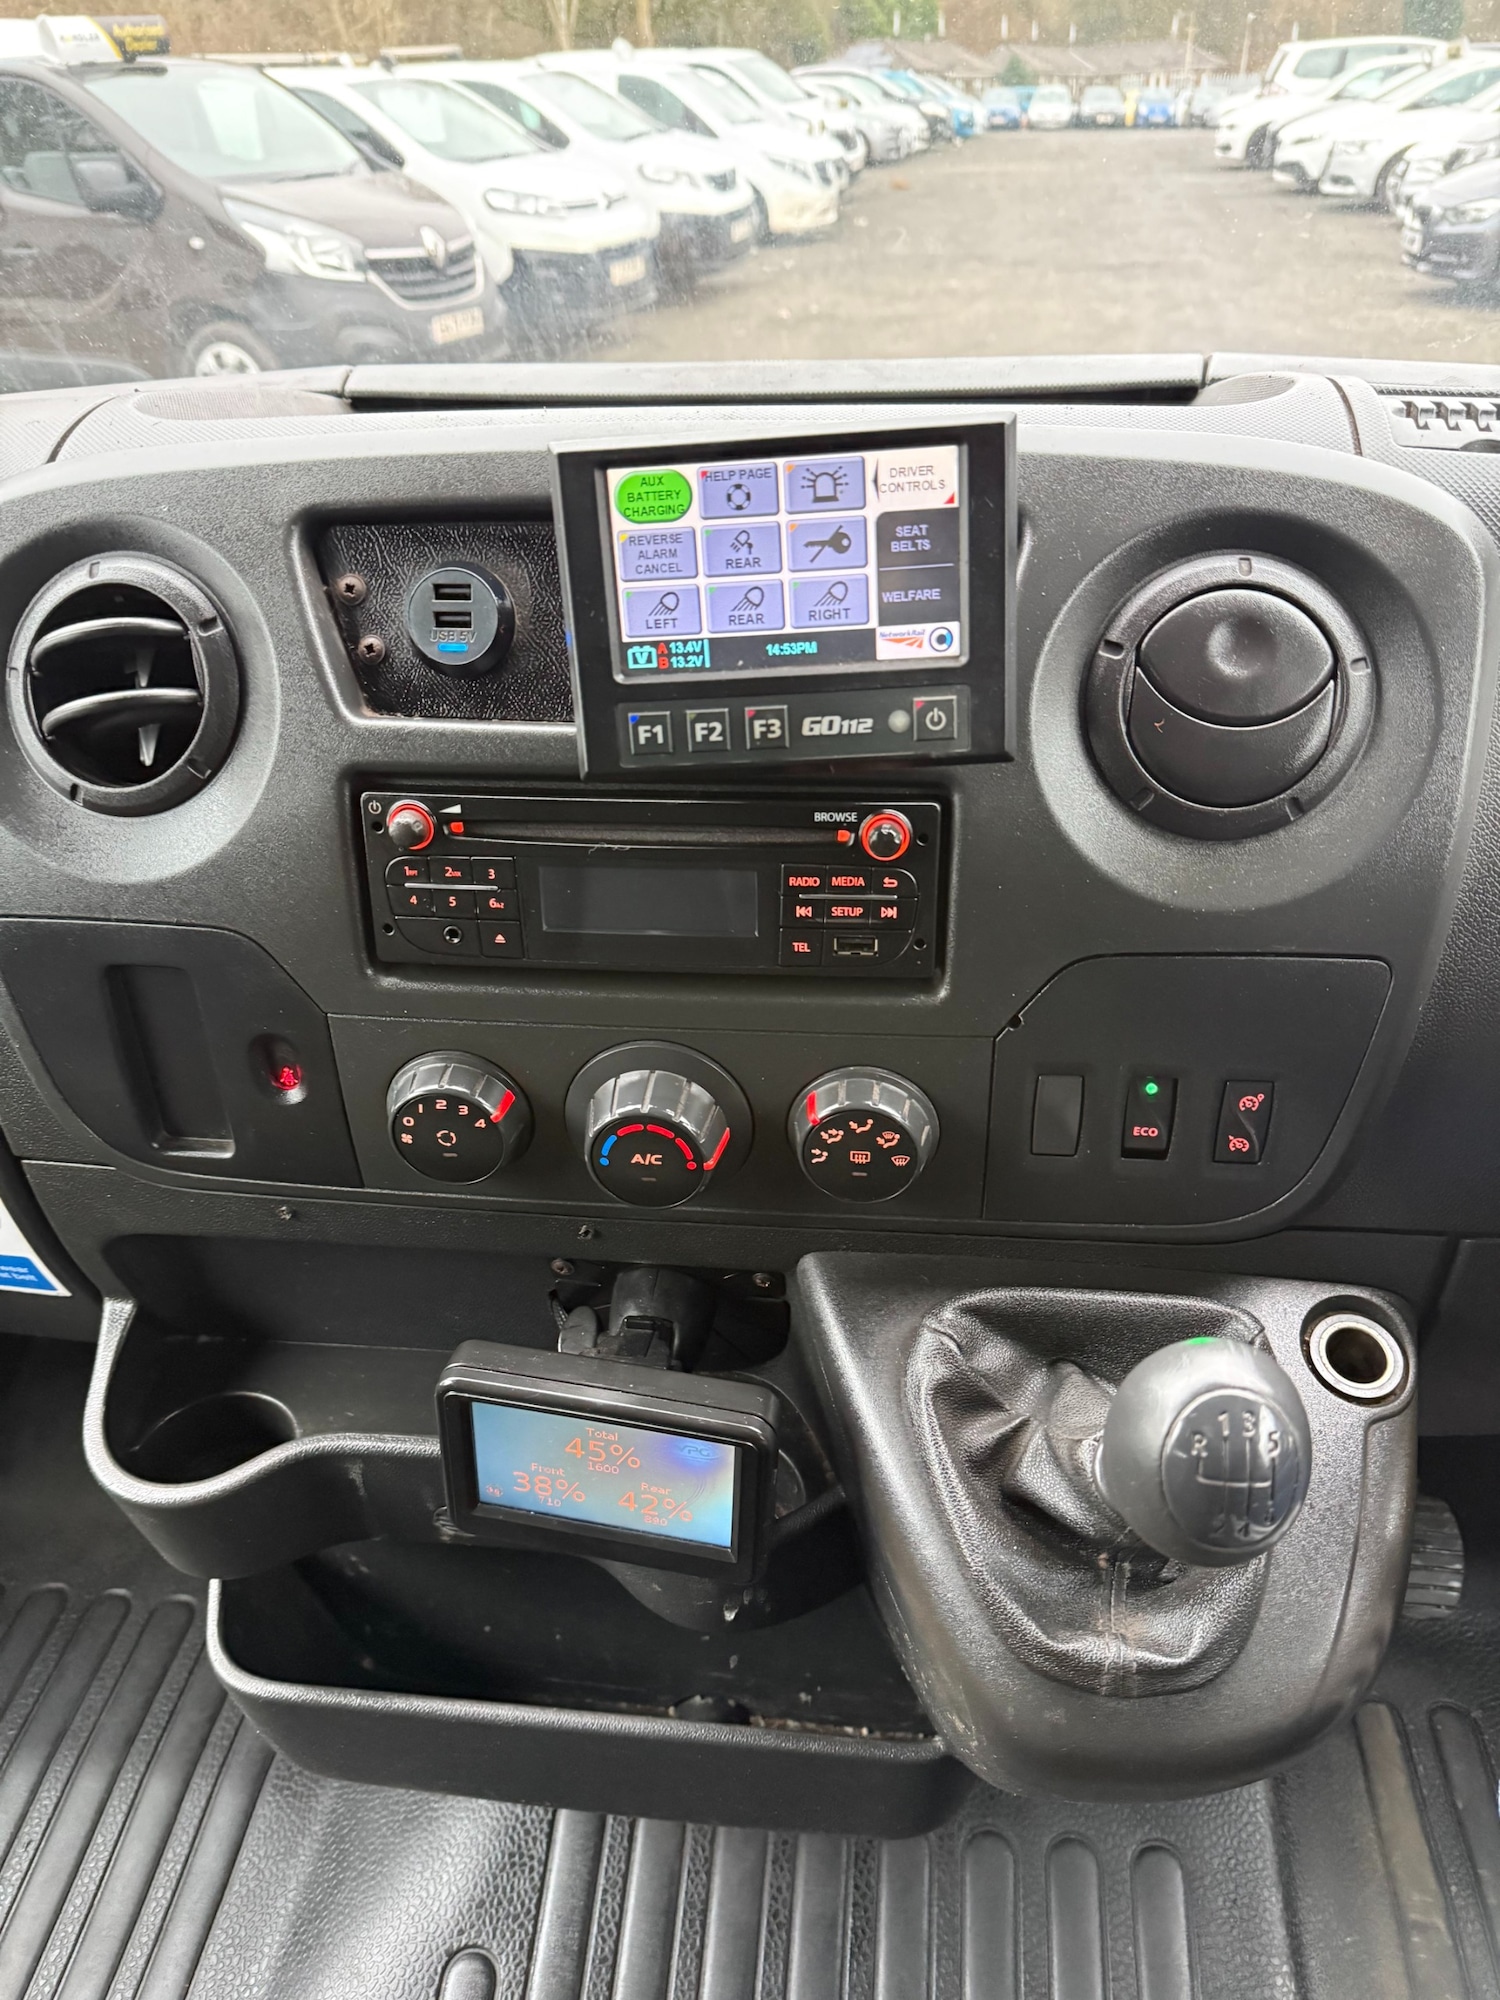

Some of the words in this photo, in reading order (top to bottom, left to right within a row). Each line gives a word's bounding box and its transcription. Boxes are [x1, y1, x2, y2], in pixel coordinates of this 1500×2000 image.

[704, 470, 736, 482] HELP
[739, 467, 772, 480] PAGE
[889, 465, 934, 478] DRIVER
[640, 476, 664, 487] AUX
[879, 479, 946, 494] CONTROLS
[627, 489, 682, 502] BATTERY
[623, 504, 685, 517] CHARGING
[895, 524, 928, 537] SEAT
[628, 533, 683, 546] REVERSE
[891, 539, 931, 552] BELTS
[637, 548, 678, 560] ALARM
[635, 563, 683, 574] CANCEL
[725, 557, 762, 569] REAR
[882, 588, 941, 603] WELFARE
[728, 613, 765, 626] REAR
[808, 608, 851, 621] RIGHT
[645, 618, 679, 630] LEFT
[429, 630, 457, 643] USB
[459, 630, 478, 643] 5V
[658, 642, 668, 654] A
[669, 640, 703, 654] 13.4V
[765, 641, 818, 657] 14:53PM
[658, 656, 669, 669] B
[670, 655, 703, 669] 13.2V
[637, 724, 664, 745] F1
[694, 721, 723, 743] F2
[752, 719, 782, 740] F3
[814, 811, 858, 823] BROWSE
[487, 868, 496, 880] 3
[788, 876, 821, 887] RADIO
[831, 876, 865, 887] MEDIA
[409, 895, 418, 905] 4
[449, 896, 457, 907] 5
[831, 906, 864, 918] SETUP
[792, 942, 811, 953] TEL
[417, 1103, 424, 1114] 1
[435, 1099, 447, 1110] 2
[458, 1105, 469, 1115] 3
[474, 1118, 487, 1129] 4
[1132, 1126, 1159, 1137] ECO
[630, 1153, 663, 1166] A/C
[1217, 1411, 1230, 1437] 1
[1241, 1410, 1256, 1437] 3
[586, 1427, 618, 1441] Total
[1191, 1432, 1208, 1457] R
[1267, 1430, 1280, 1458] 5
[564, 1437, 641, 1468] 45%
[531, 1462, 565, 1477] Front
[587, 1462, 620, 1475] 1600
[512, 1471, 586, 1502] 38%
[641, 1482, 672, 1495] Rear
[538, 1495, 562, 1507] 710
[618, 1491, 693, 1522] 42%
